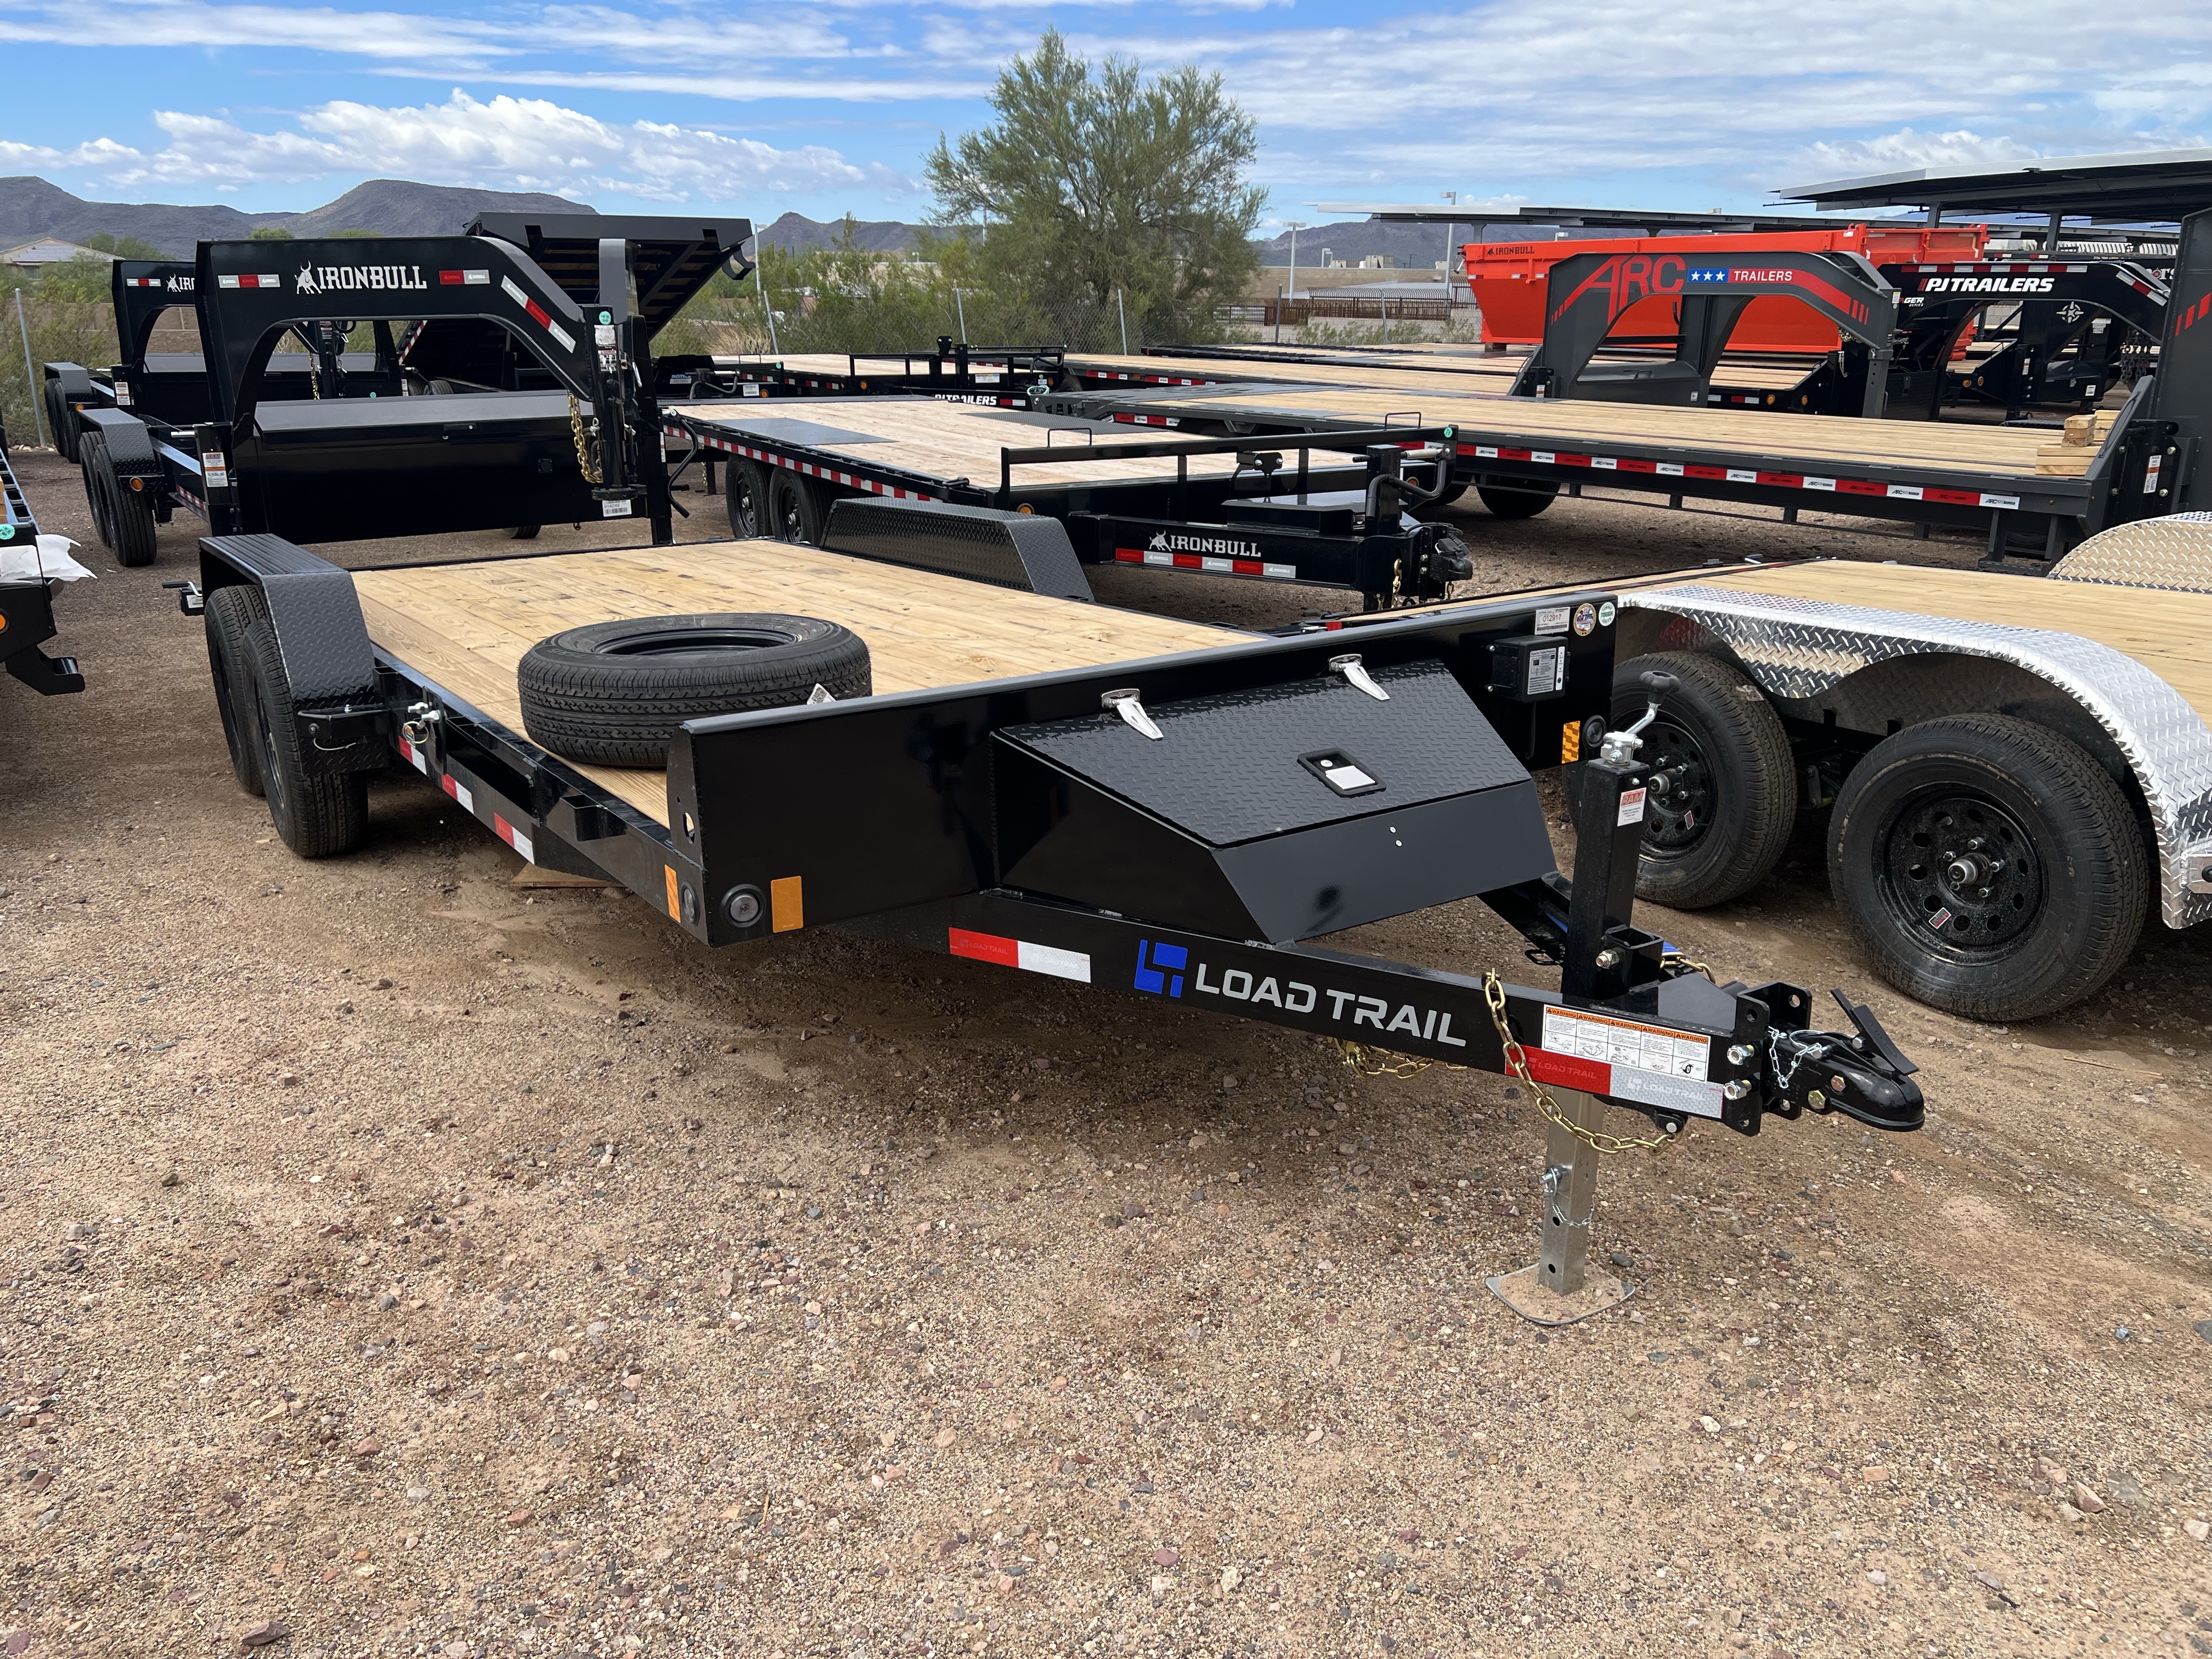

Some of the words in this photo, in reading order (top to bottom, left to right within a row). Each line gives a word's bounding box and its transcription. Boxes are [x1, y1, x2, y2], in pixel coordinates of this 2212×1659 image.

[1495, 246, 1534, 255] IRONBULL
[317, 266, 427, 290] IRONBULL
[1564, 255, 1686, 325] ARC
[1734, 270, 1793, 281] TRAILERS
[1170, 535, 1261, 557] IRONBULL
[1543, 613, 1562, 622] 012917
[1621, 792, 1644, 806] RAM
[988, 946, 1008, 955] TRAIL
[1195, 963, 1317, 1013] LOAD
[1326, 989, 1466, 1047] TRAIL
[1551, 1009, 1577, 1018] WARNING
[1583, 1014, 1608, 1024] WARNING
[1615, 1021, 1641, 1030] WARNING
[1648, 1027, 1674, 1037] WARNING
[1681, 1034, 1708, 1043] WARNING
[1538, 1061, 1566, 1073] LOAD
[1567, 1067, 1597, 1079] TRAIL
[1643, 1082, 1673, 1094] LOAD
[1674, 1088, 1705, 1101] TRAIL
